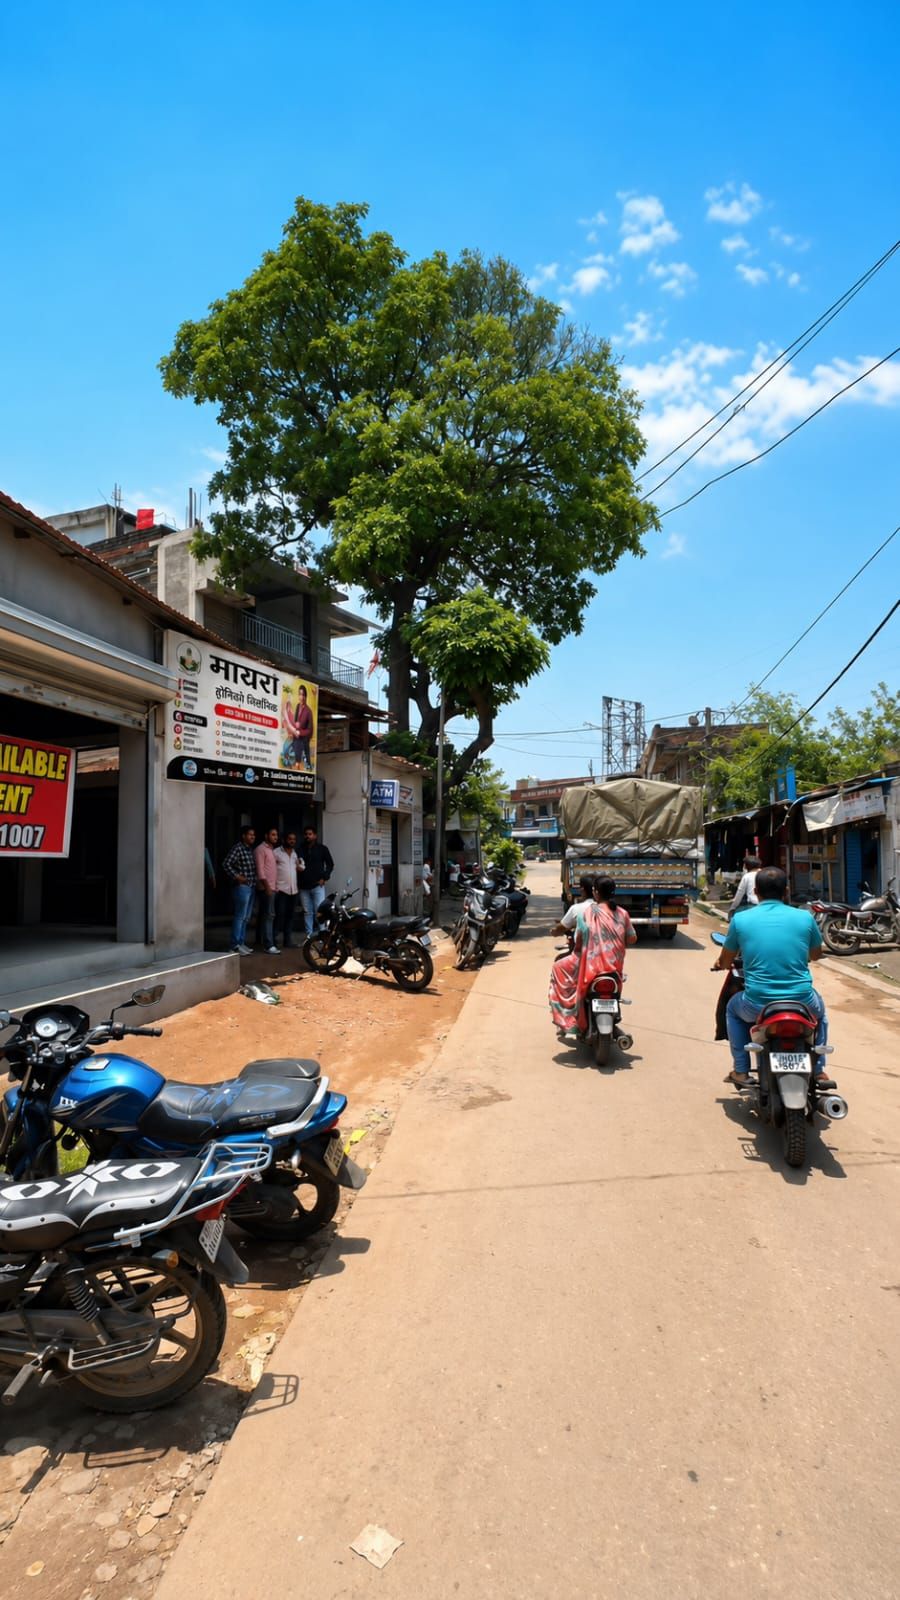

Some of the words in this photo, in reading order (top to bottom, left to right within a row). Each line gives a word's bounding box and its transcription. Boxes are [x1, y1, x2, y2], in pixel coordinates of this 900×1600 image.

[0, 743, 67, 780] ILABLE
[372, 788, 393, 798] ATM
[0, 823, 45, 848] 1007
